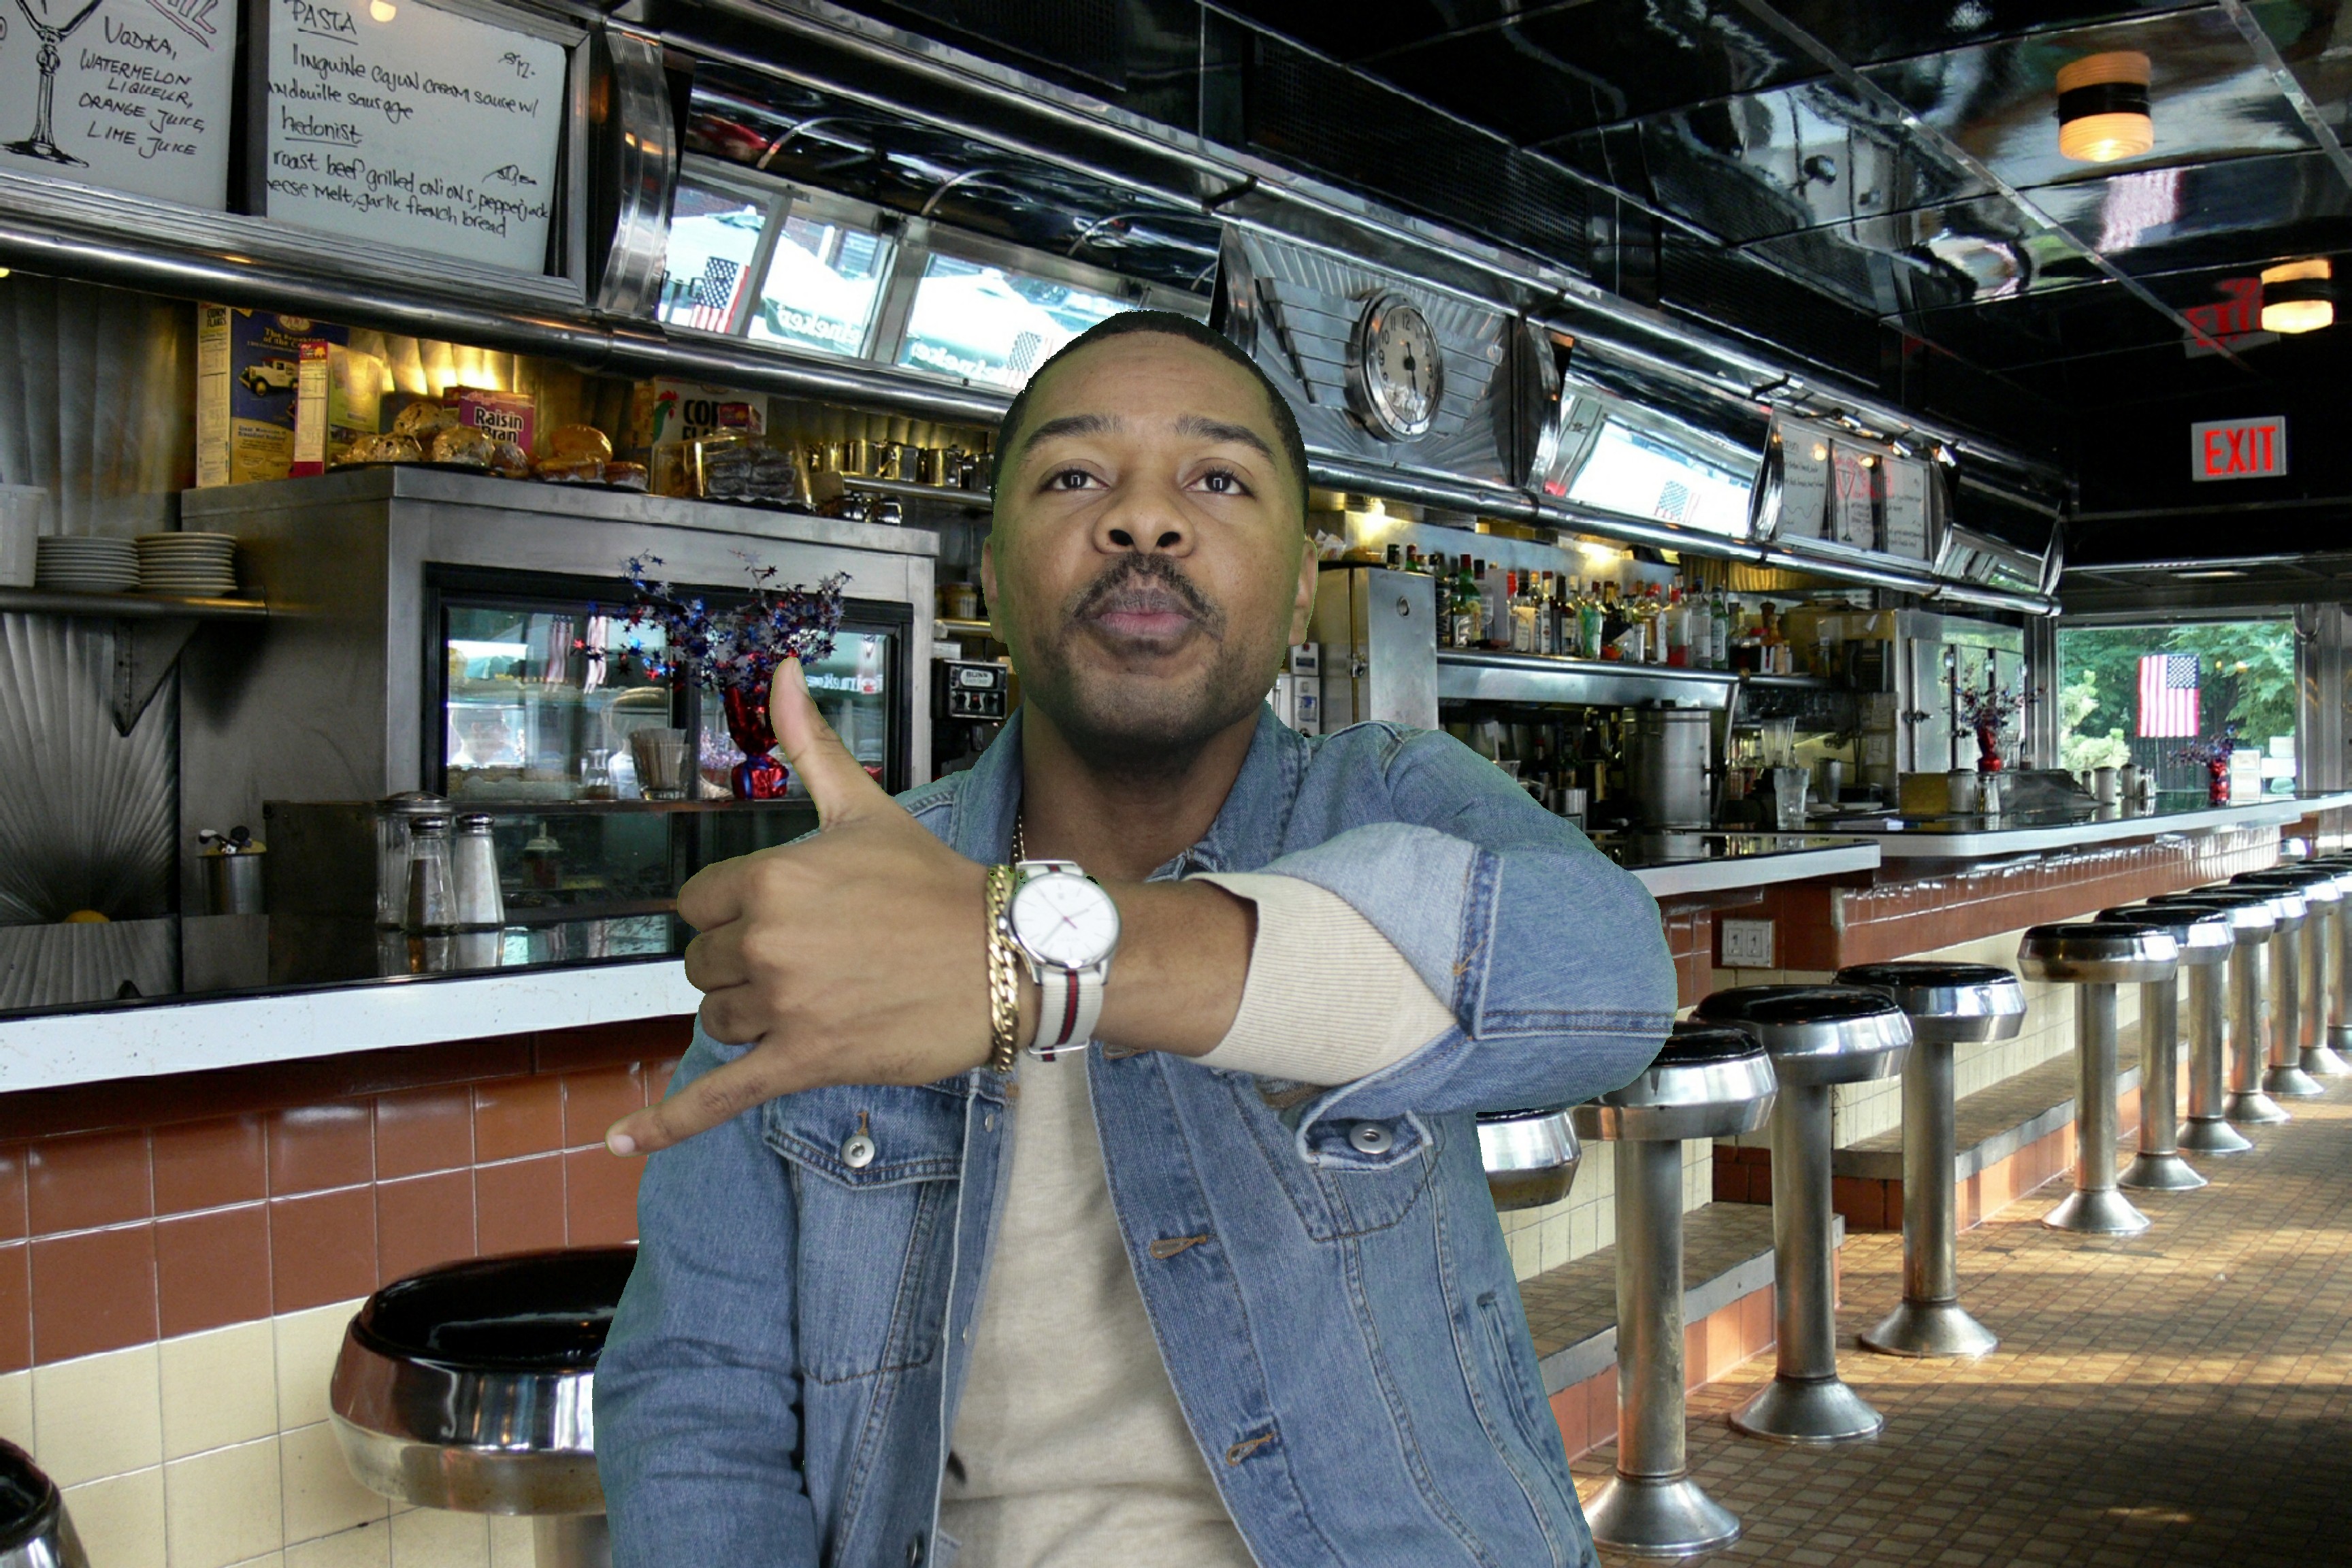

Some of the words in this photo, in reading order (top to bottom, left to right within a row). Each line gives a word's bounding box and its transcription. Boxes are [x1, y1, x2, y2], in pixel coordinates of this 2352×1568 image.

[284, 0, 357, 35] PASTA
[80, 48, 193, 85] WATERMELON
[78, 92, 146, 117] ORANGE
[108, 77, 193, 109] LIQUEUR,
[87, 120, 136, 144] LIME
[138, 137, 197, 159] JUICE
[1402, 312, 1411, 331] 12
[1382, 329, 1390, 345] 10
[1379, 350, 1385, 366] 9
[475, 408, 523, 431] Raisin
[2204, 425, 2276, 476] EXIT
